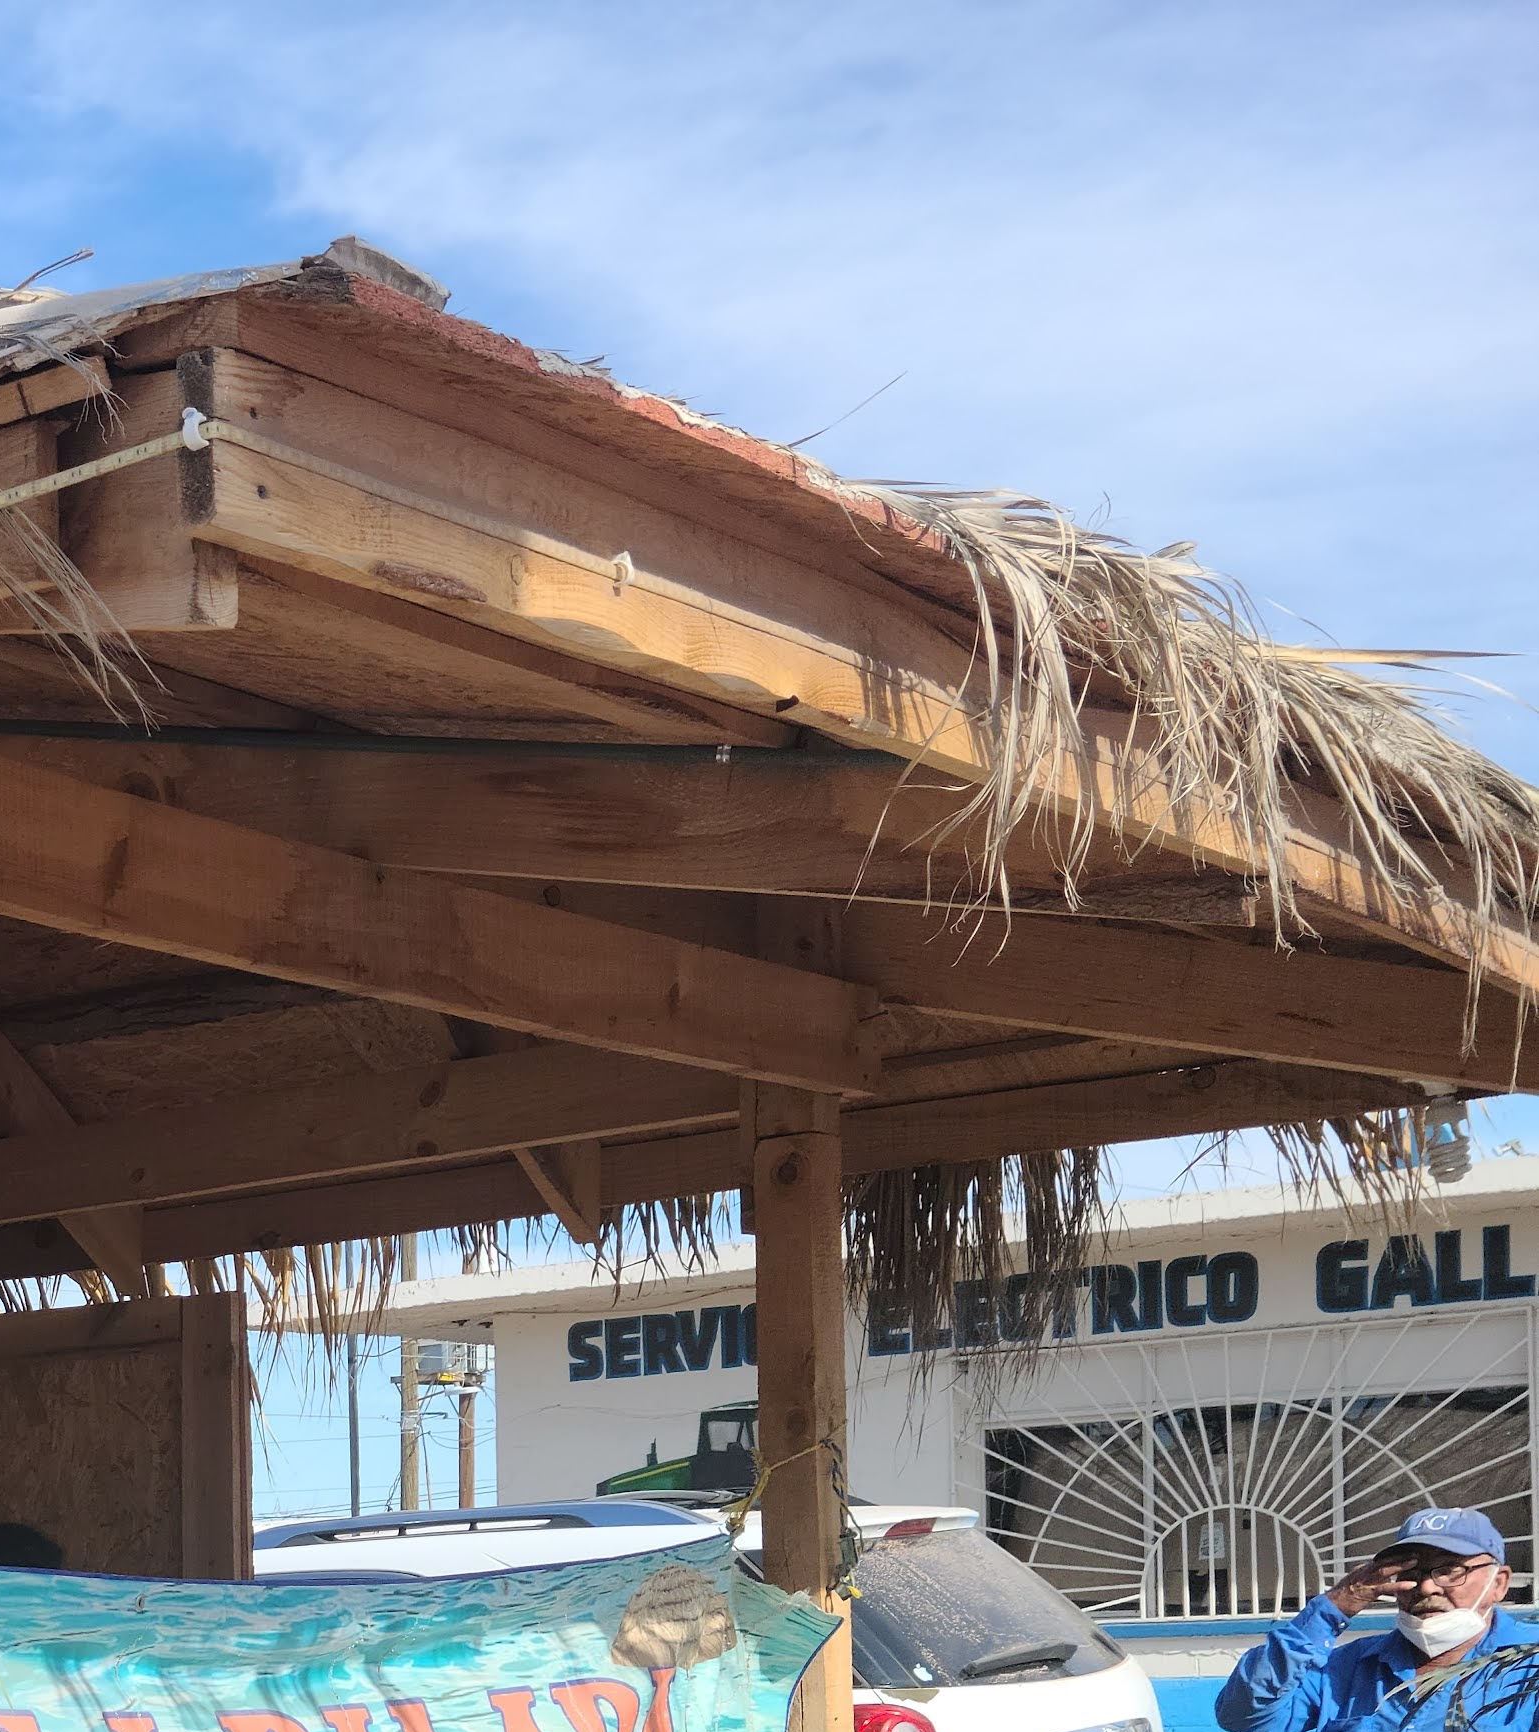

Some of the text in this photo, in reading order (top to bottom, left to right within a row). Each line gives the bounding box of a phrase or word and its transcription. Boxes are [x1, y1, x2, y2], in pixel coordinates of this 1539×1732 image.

[567, 1302, 759, 1382] SERVI
[1315, 1224, 1539, 1314] GALL
[1415, 1514, 1448, 1531] KC
